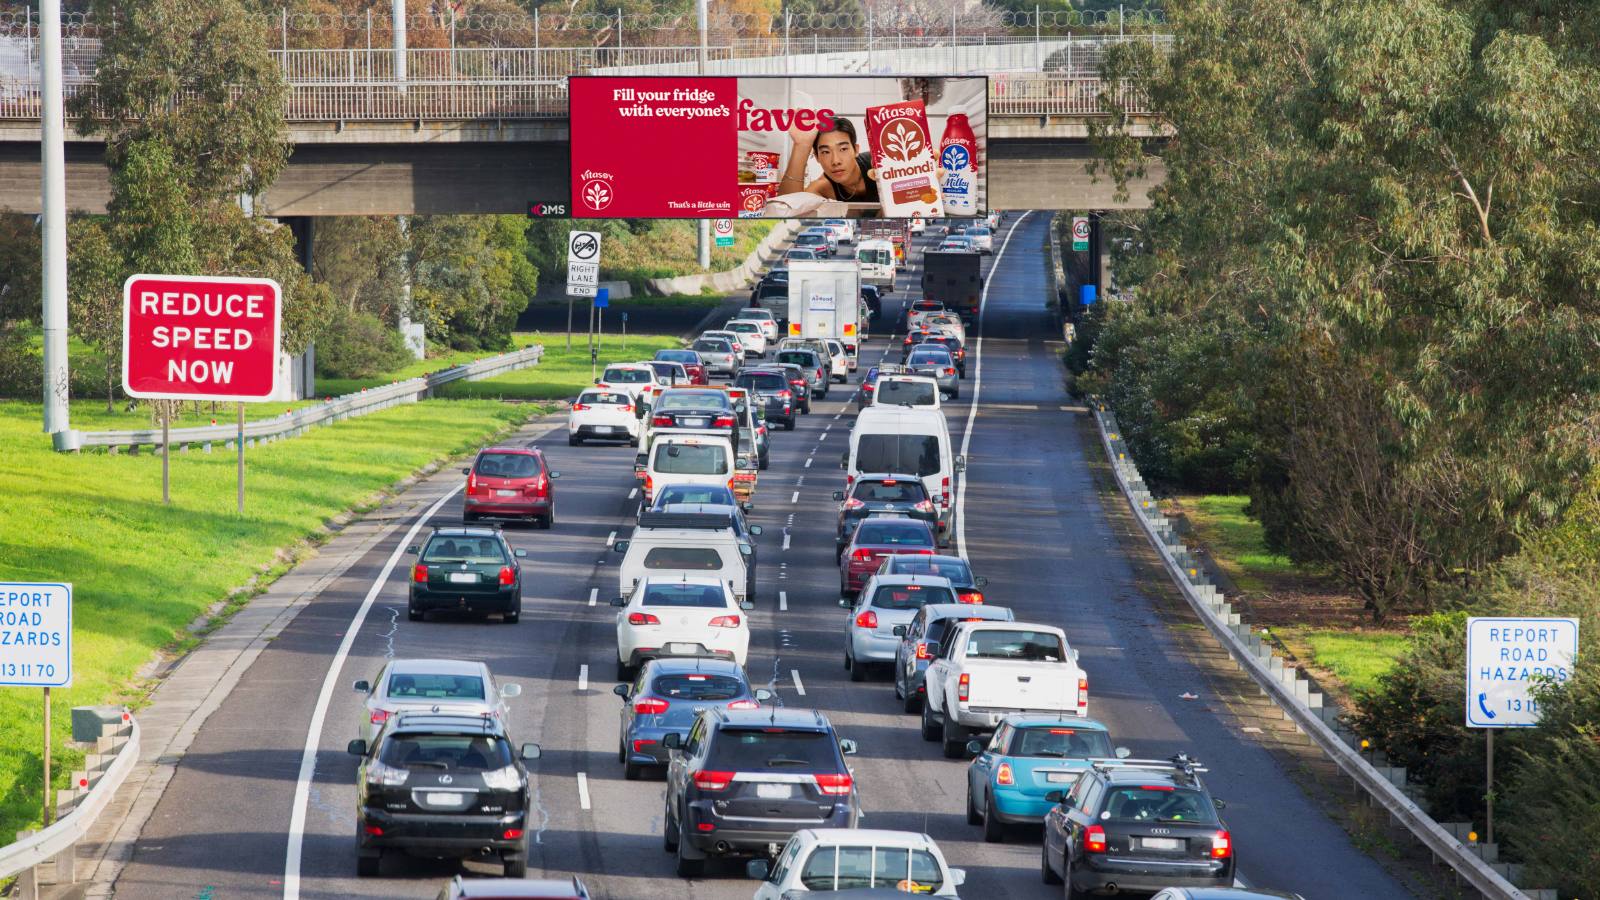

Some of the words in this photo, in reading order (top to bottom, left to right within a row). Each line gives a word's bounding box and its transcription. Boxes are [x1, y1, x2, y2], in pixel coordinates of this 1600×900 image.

[613, 88, 635, 101] Fill
[637, 91, 671, 104] your
[673, 88, 715, 104] fridge
[619, 104, 653, 117] with
[655, 104, 730, 119] everyone's
[737, 98, 835, 132] faves
[882, 161, 930, 180] almond
[697, 201, 715, 209] little
[716, 201, 731, 209] win
[718, 220, 730, 229] 60
[1077, 225, 1088, 234] 60
[571, 264, 596, 273] RIGHT
[571, 275, 594, 283] LANE
[140, 291, 264, 318] REDUCE
[151, 326, 253, 351] SPEED
[167, 359, 234, 384] NOW
[1490, 628, 1558, 642] REPORT
[1500, 647, 1548, 662] ROAD
[2, 663, 16, 677] 13
[21, 663, 31, 677] 11
[36, 664, 55, 677] 70
[1507, 699, 1522, 712] 13
